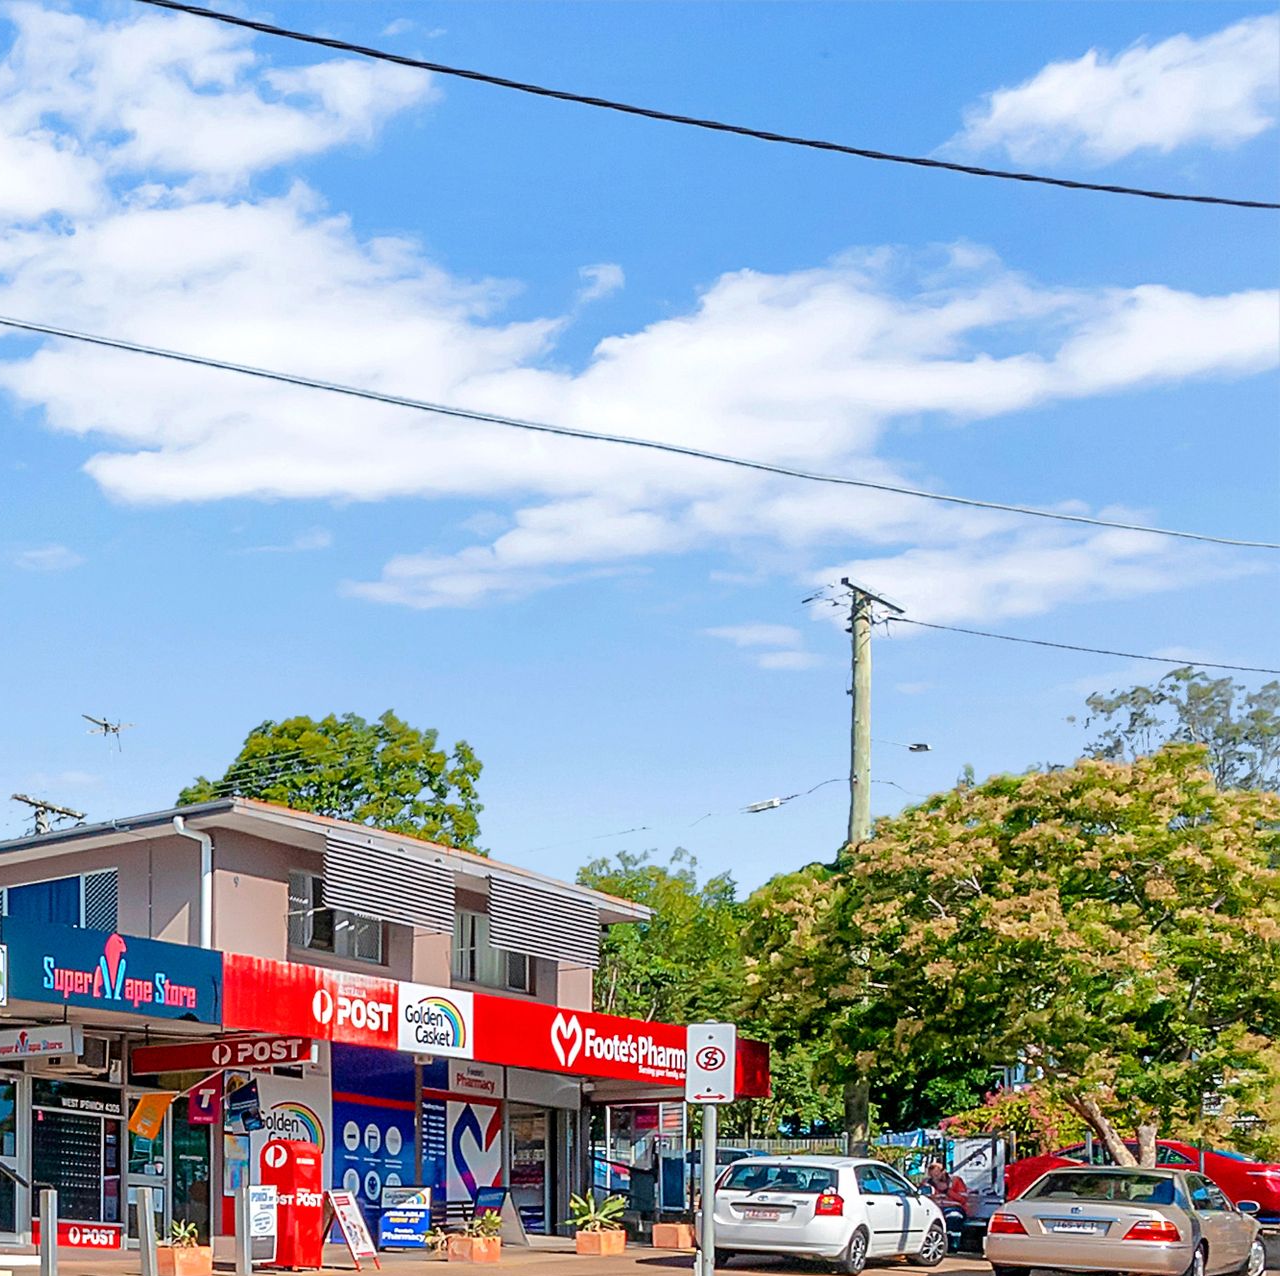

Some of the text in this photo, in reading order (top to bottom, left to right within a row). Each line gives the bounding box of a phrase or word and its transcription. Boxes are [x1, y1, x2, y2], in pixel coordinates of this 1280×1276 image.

[43, 955, 92, 999] Super
[155, 972, 197, 1008] Store
[337, 996, 393, 1032] POST
[405, 1004, 444, 1028] Golden
[415, 1025, 451, 1047] Casket
[237, 1038, 303, 1063] POST
[584, 1028, 686, 1070] Foote's Pharm
[456, 1072, 495, 1094] Pharmacy
[198, 1088, 216, 1108] T
[296, 1192, 323, 1207] POST
[81, 1228, 115, 1246] POST
[382, 1231, 426, 1243] Pharmacy
